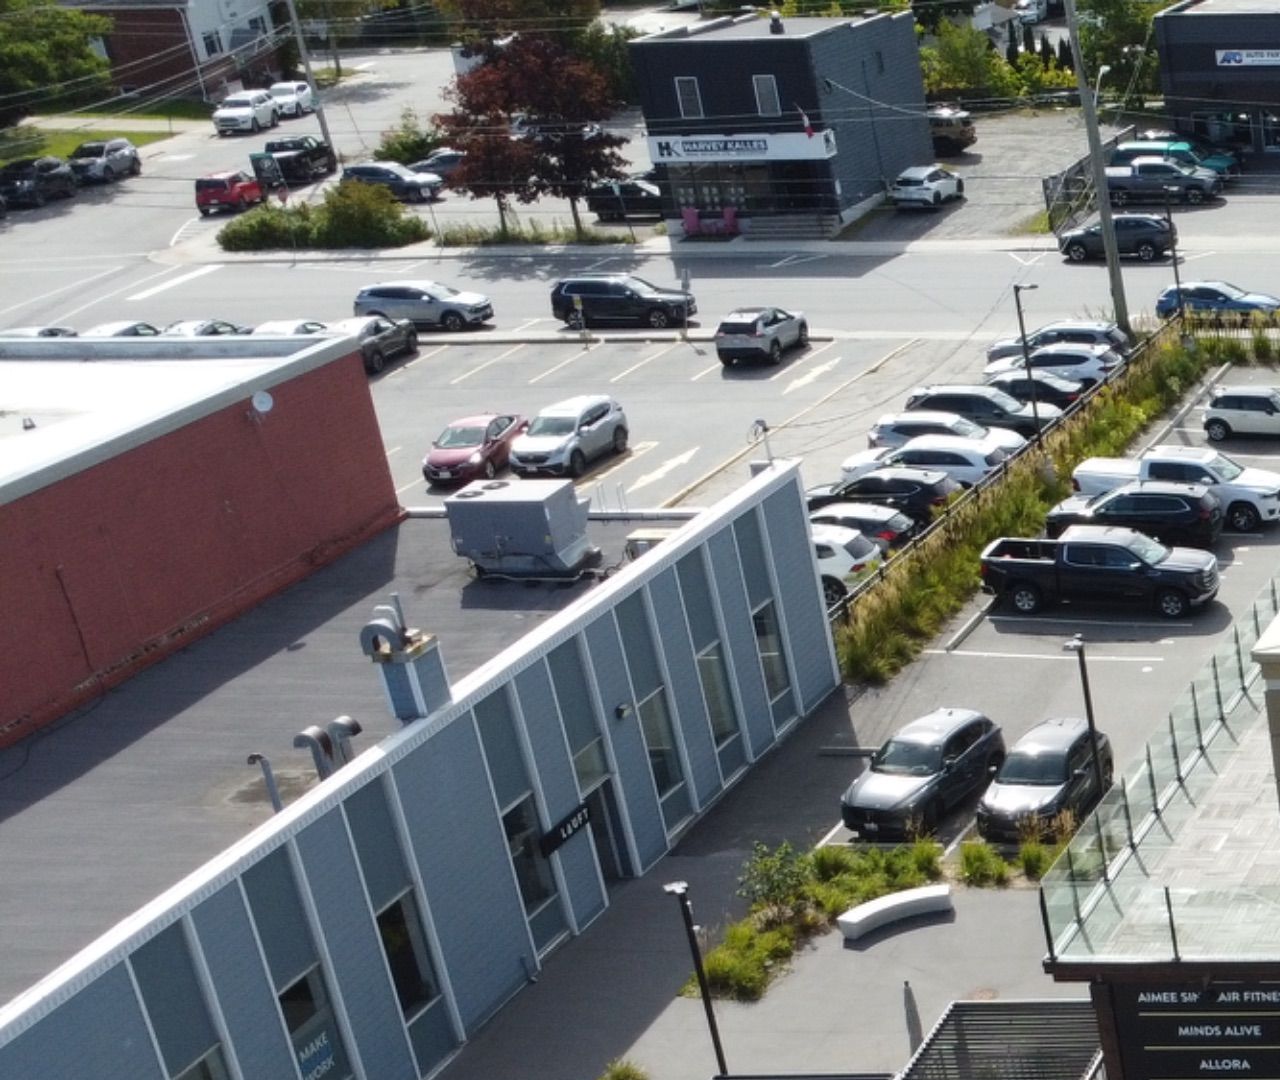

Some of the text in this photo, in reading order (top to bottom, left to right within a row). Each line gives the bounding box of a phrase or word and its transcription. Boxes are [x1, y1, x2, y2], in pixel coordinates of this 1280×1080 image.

[1137, 991, 1178, 1003] AIMEE
[1178, 1025, 1262, 1036] MINDS ALIVE
[1199, 1059, 1251, 1070] ALLORA
